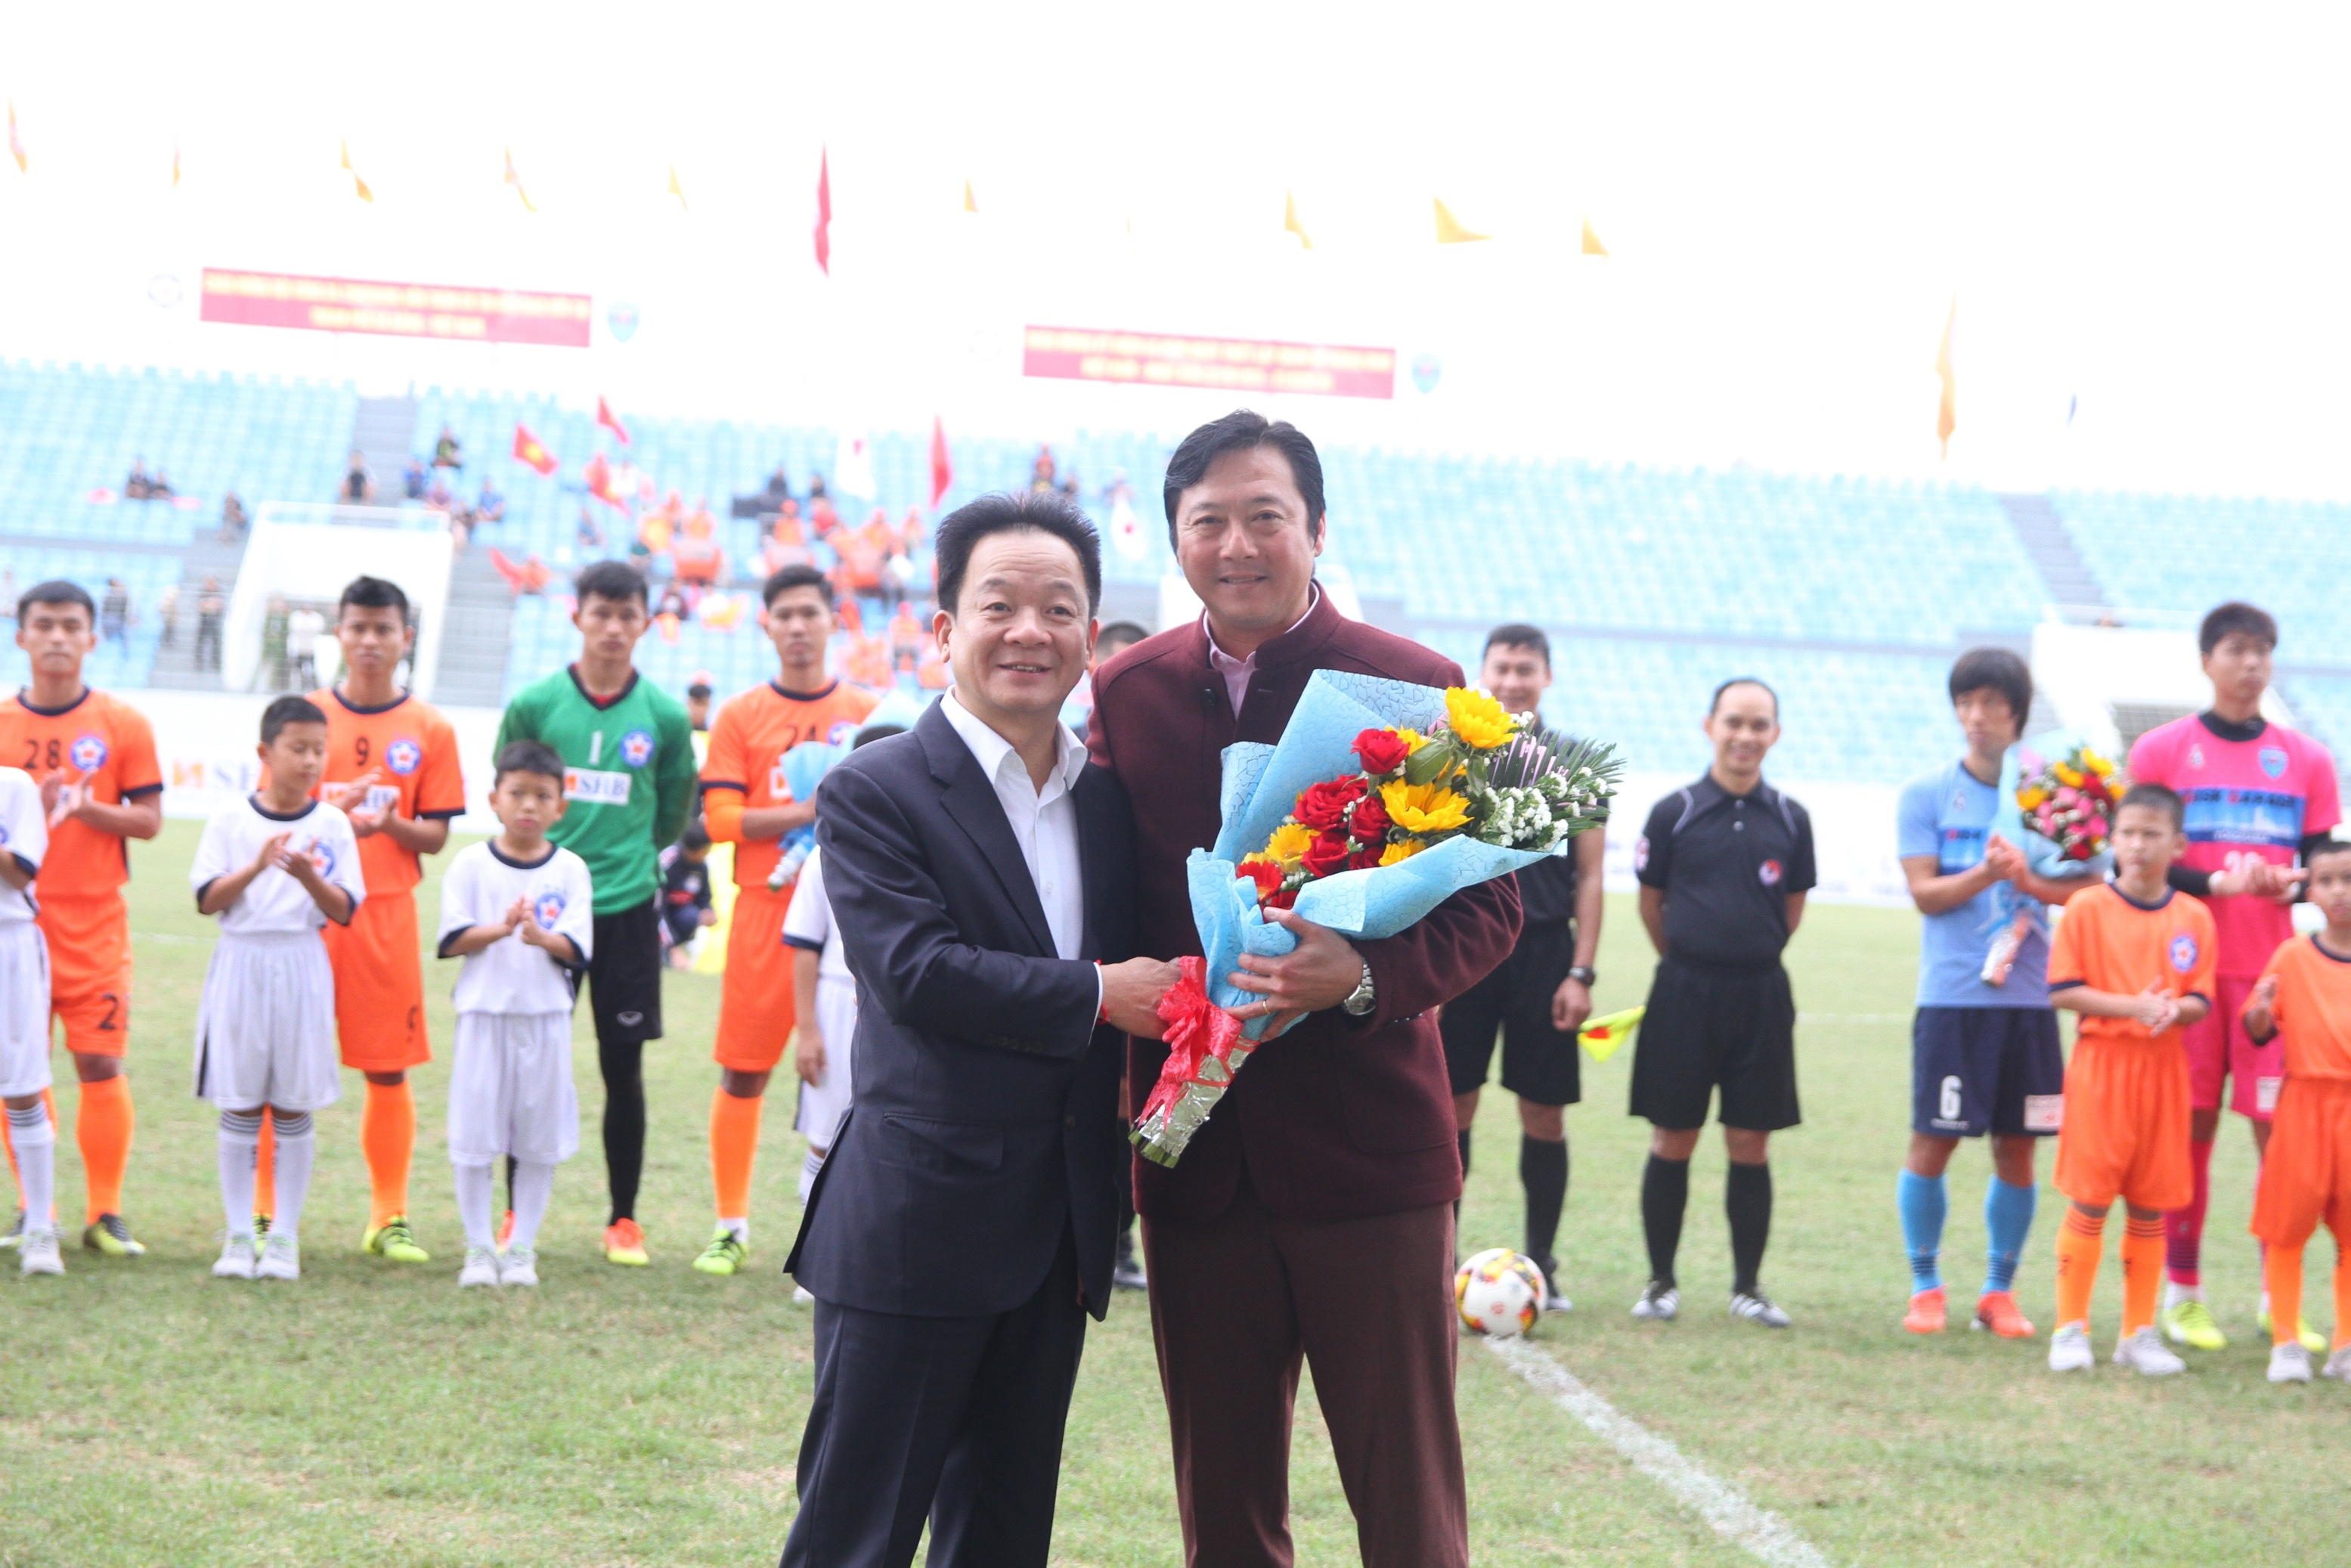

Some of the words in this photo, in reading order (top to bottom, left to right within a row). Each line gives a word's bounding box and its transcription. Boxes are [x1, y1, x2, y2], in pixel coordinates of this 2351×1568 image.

[24, 738, 61, 769] 28
[355, 736, 370, 767] 9
[1940, 1074, 1963, 1120] 6
